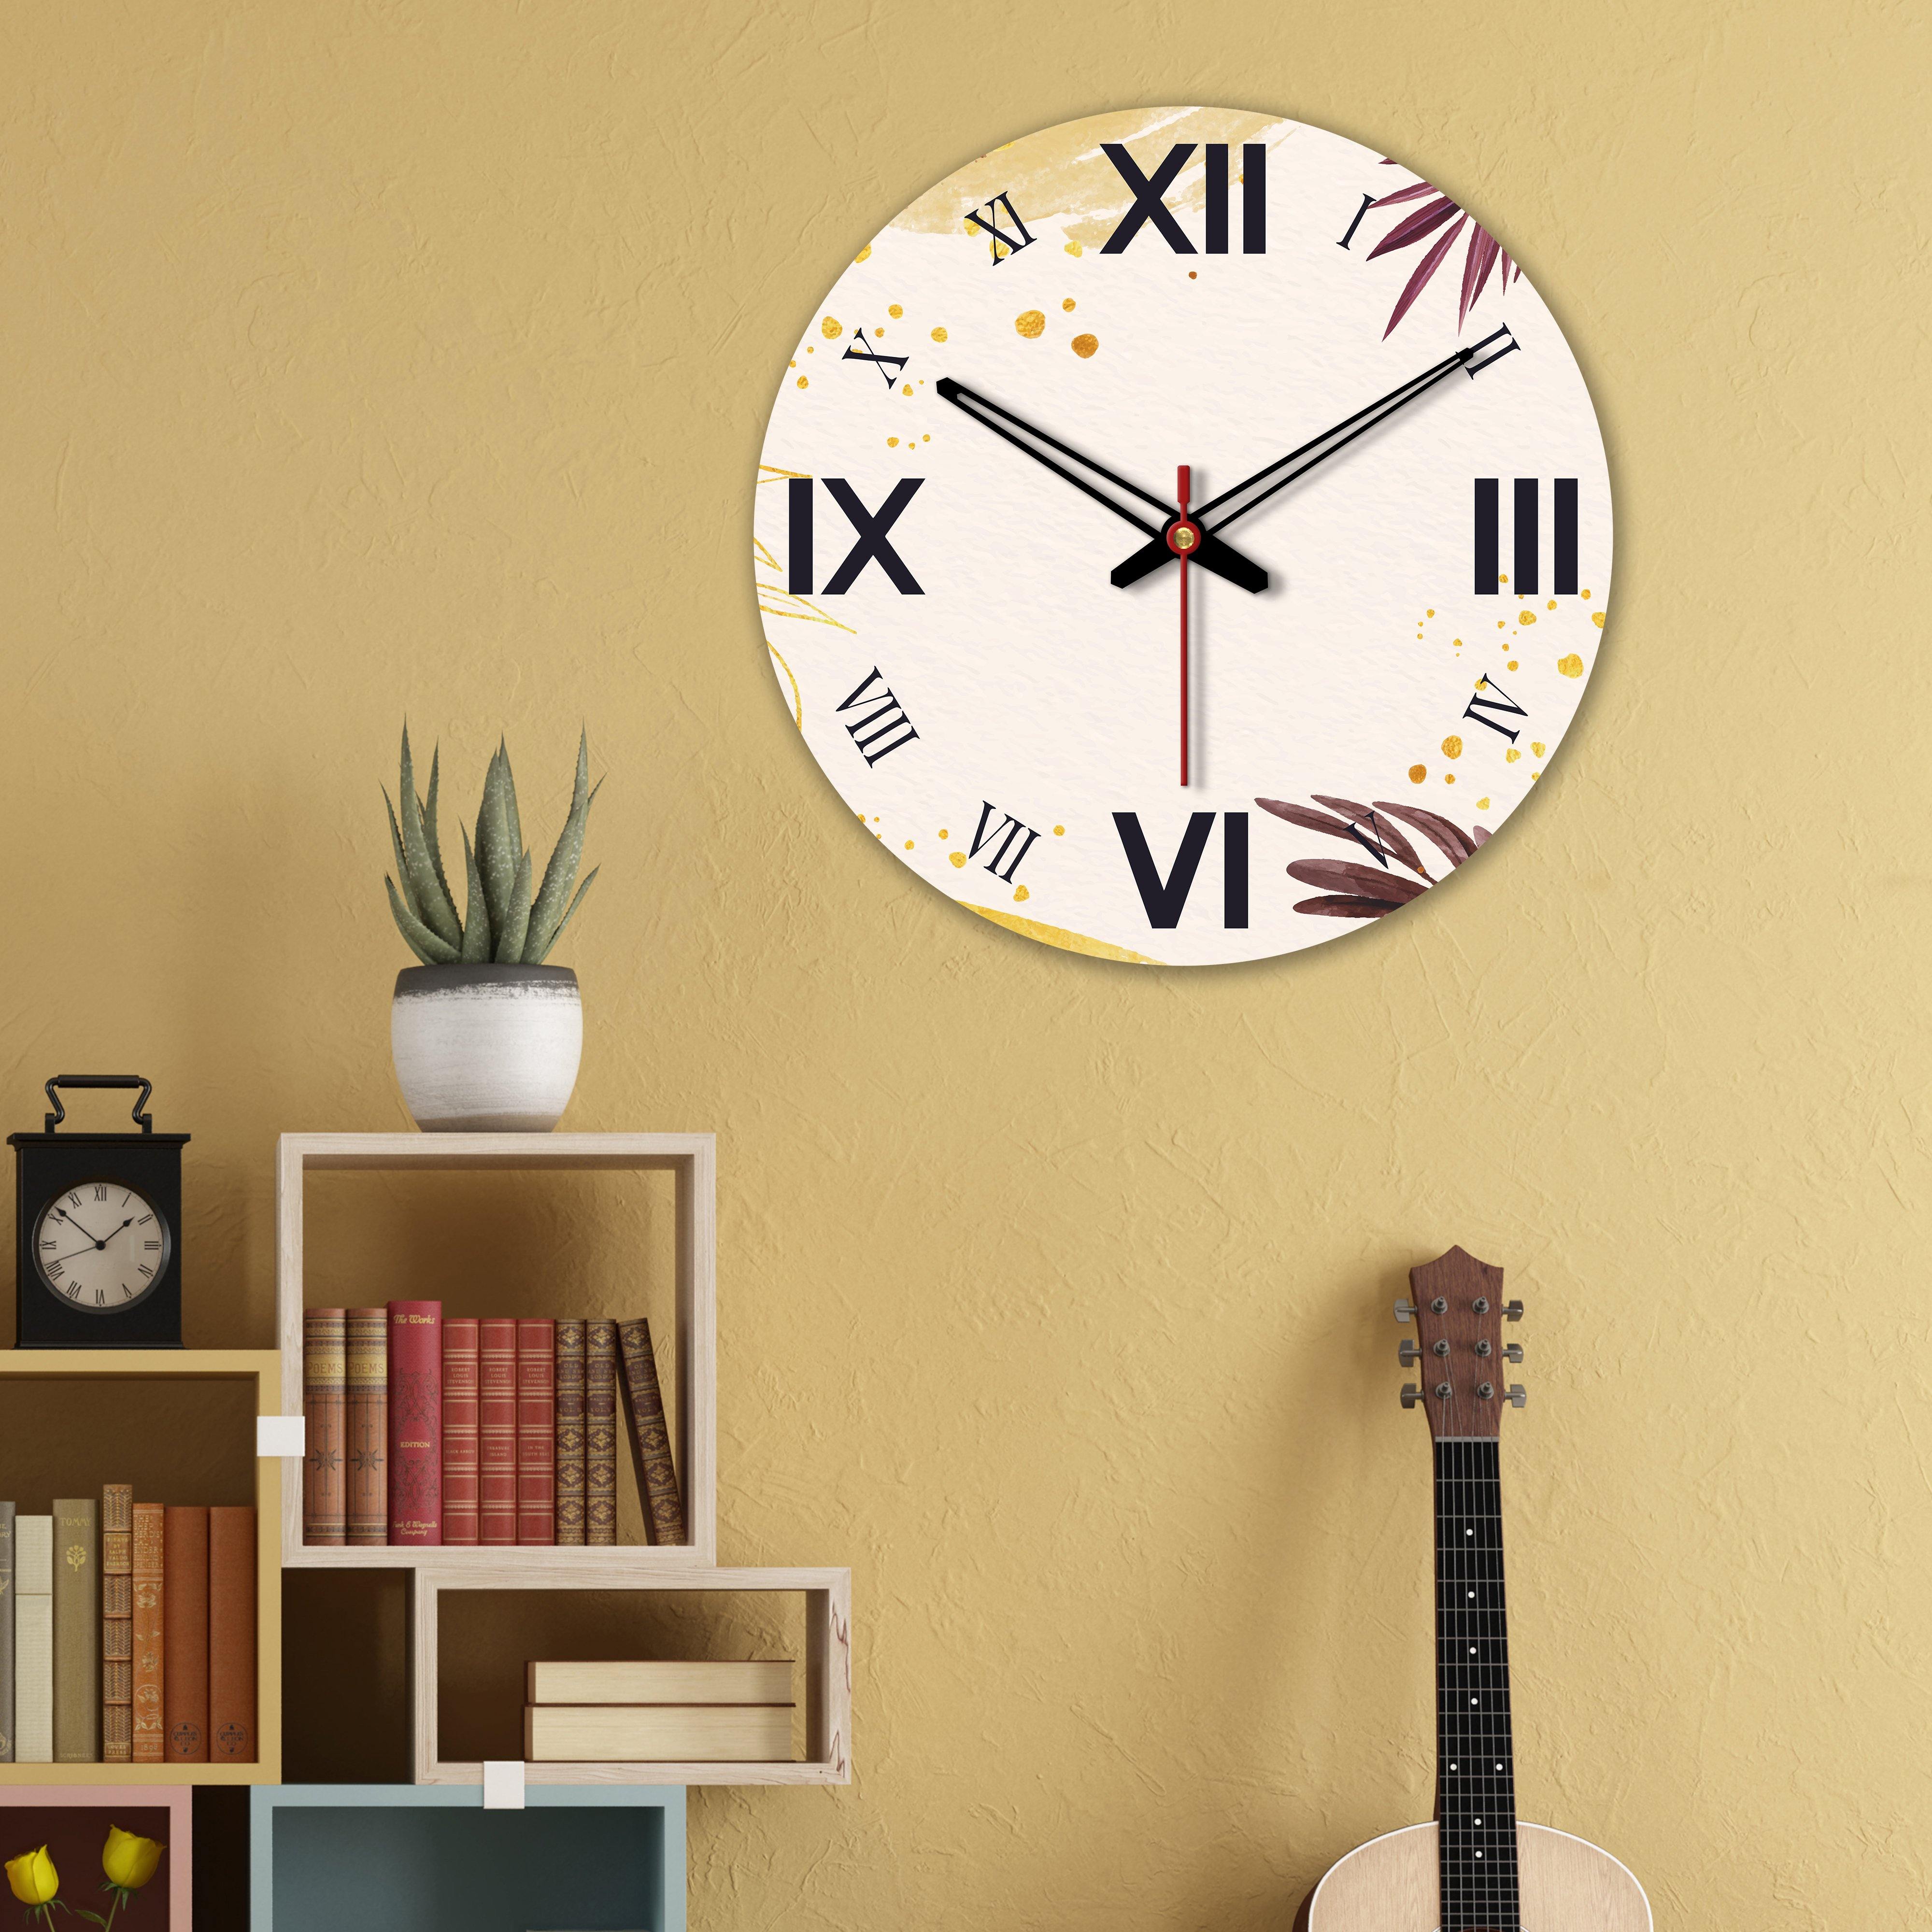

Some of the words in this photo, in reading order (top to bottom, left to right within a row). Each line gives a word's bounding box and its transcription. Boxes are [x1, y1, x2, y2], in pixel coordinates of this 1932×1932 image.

[1099, 144, 1266, 254] XII
[964, 191, 1037, 266] XI
[1336, 193, 1376, 250] I
[842, 327, 909, 389] X
[789, 478, 925, 595] IX
[1475, 478, 1578, 595] III
[1463, 673, 1528, 744] IV
[836, 666, 920, 768] VIII
[969, 800, 1041, 884] VII
[1343, 810, 1389, 869] V
[1112, 812, 1248, 928] VI
[68, 1193, 82, 1208] XI
[94, 1187, 107, 1201] XII
[49, 1213, 63, 1225] X
[138, 1214, 152, 1225] II
[42, 1240, 57, 1250] IX
[144, 1241, 159, 1250] III
[45, 1261, 65, 1280] VIII
[138, 1264, 153, 1279] IV
[66, 1280, 82, 1299] VII
[95, 1289, 105, 1304] VI
[122, 1283, 132, 1298] V
[394, 1314, 407, 1323] The
[409, 1314, 436, 1324] Works
[308, 1362, 343, 1374] POEMS
[349, 1362, 384, 1374] POEMS
[59, 1518, 92, 1526] TOMMY
[401, 1528, 427, 1536] Company
